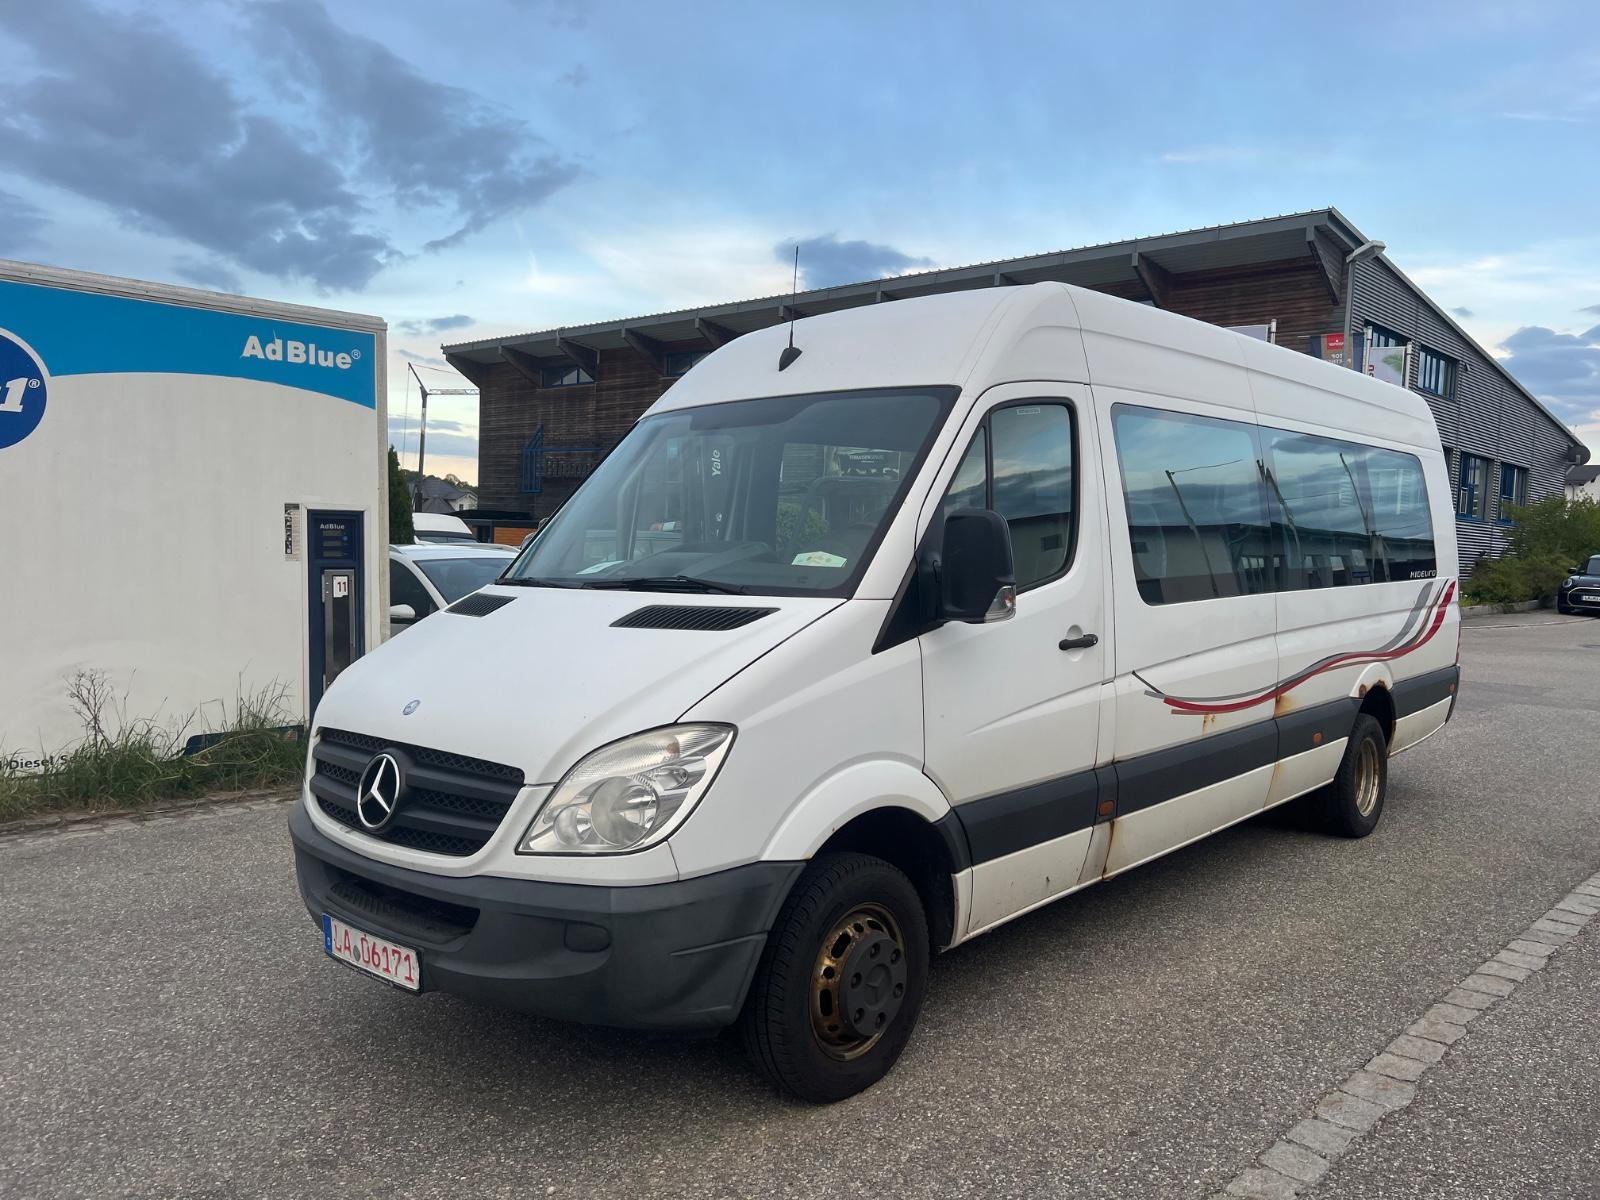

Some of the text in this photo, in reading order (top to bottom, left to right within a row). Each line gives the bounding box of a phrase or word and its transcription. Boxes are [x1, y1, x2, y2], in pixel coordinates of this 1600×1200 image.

[711, 449, 721, 477] Yale
[337, 581, 347, 593] 11
[9, 756, 54, 770] Diesel
[333, 924, 415, 983] LA 06171
